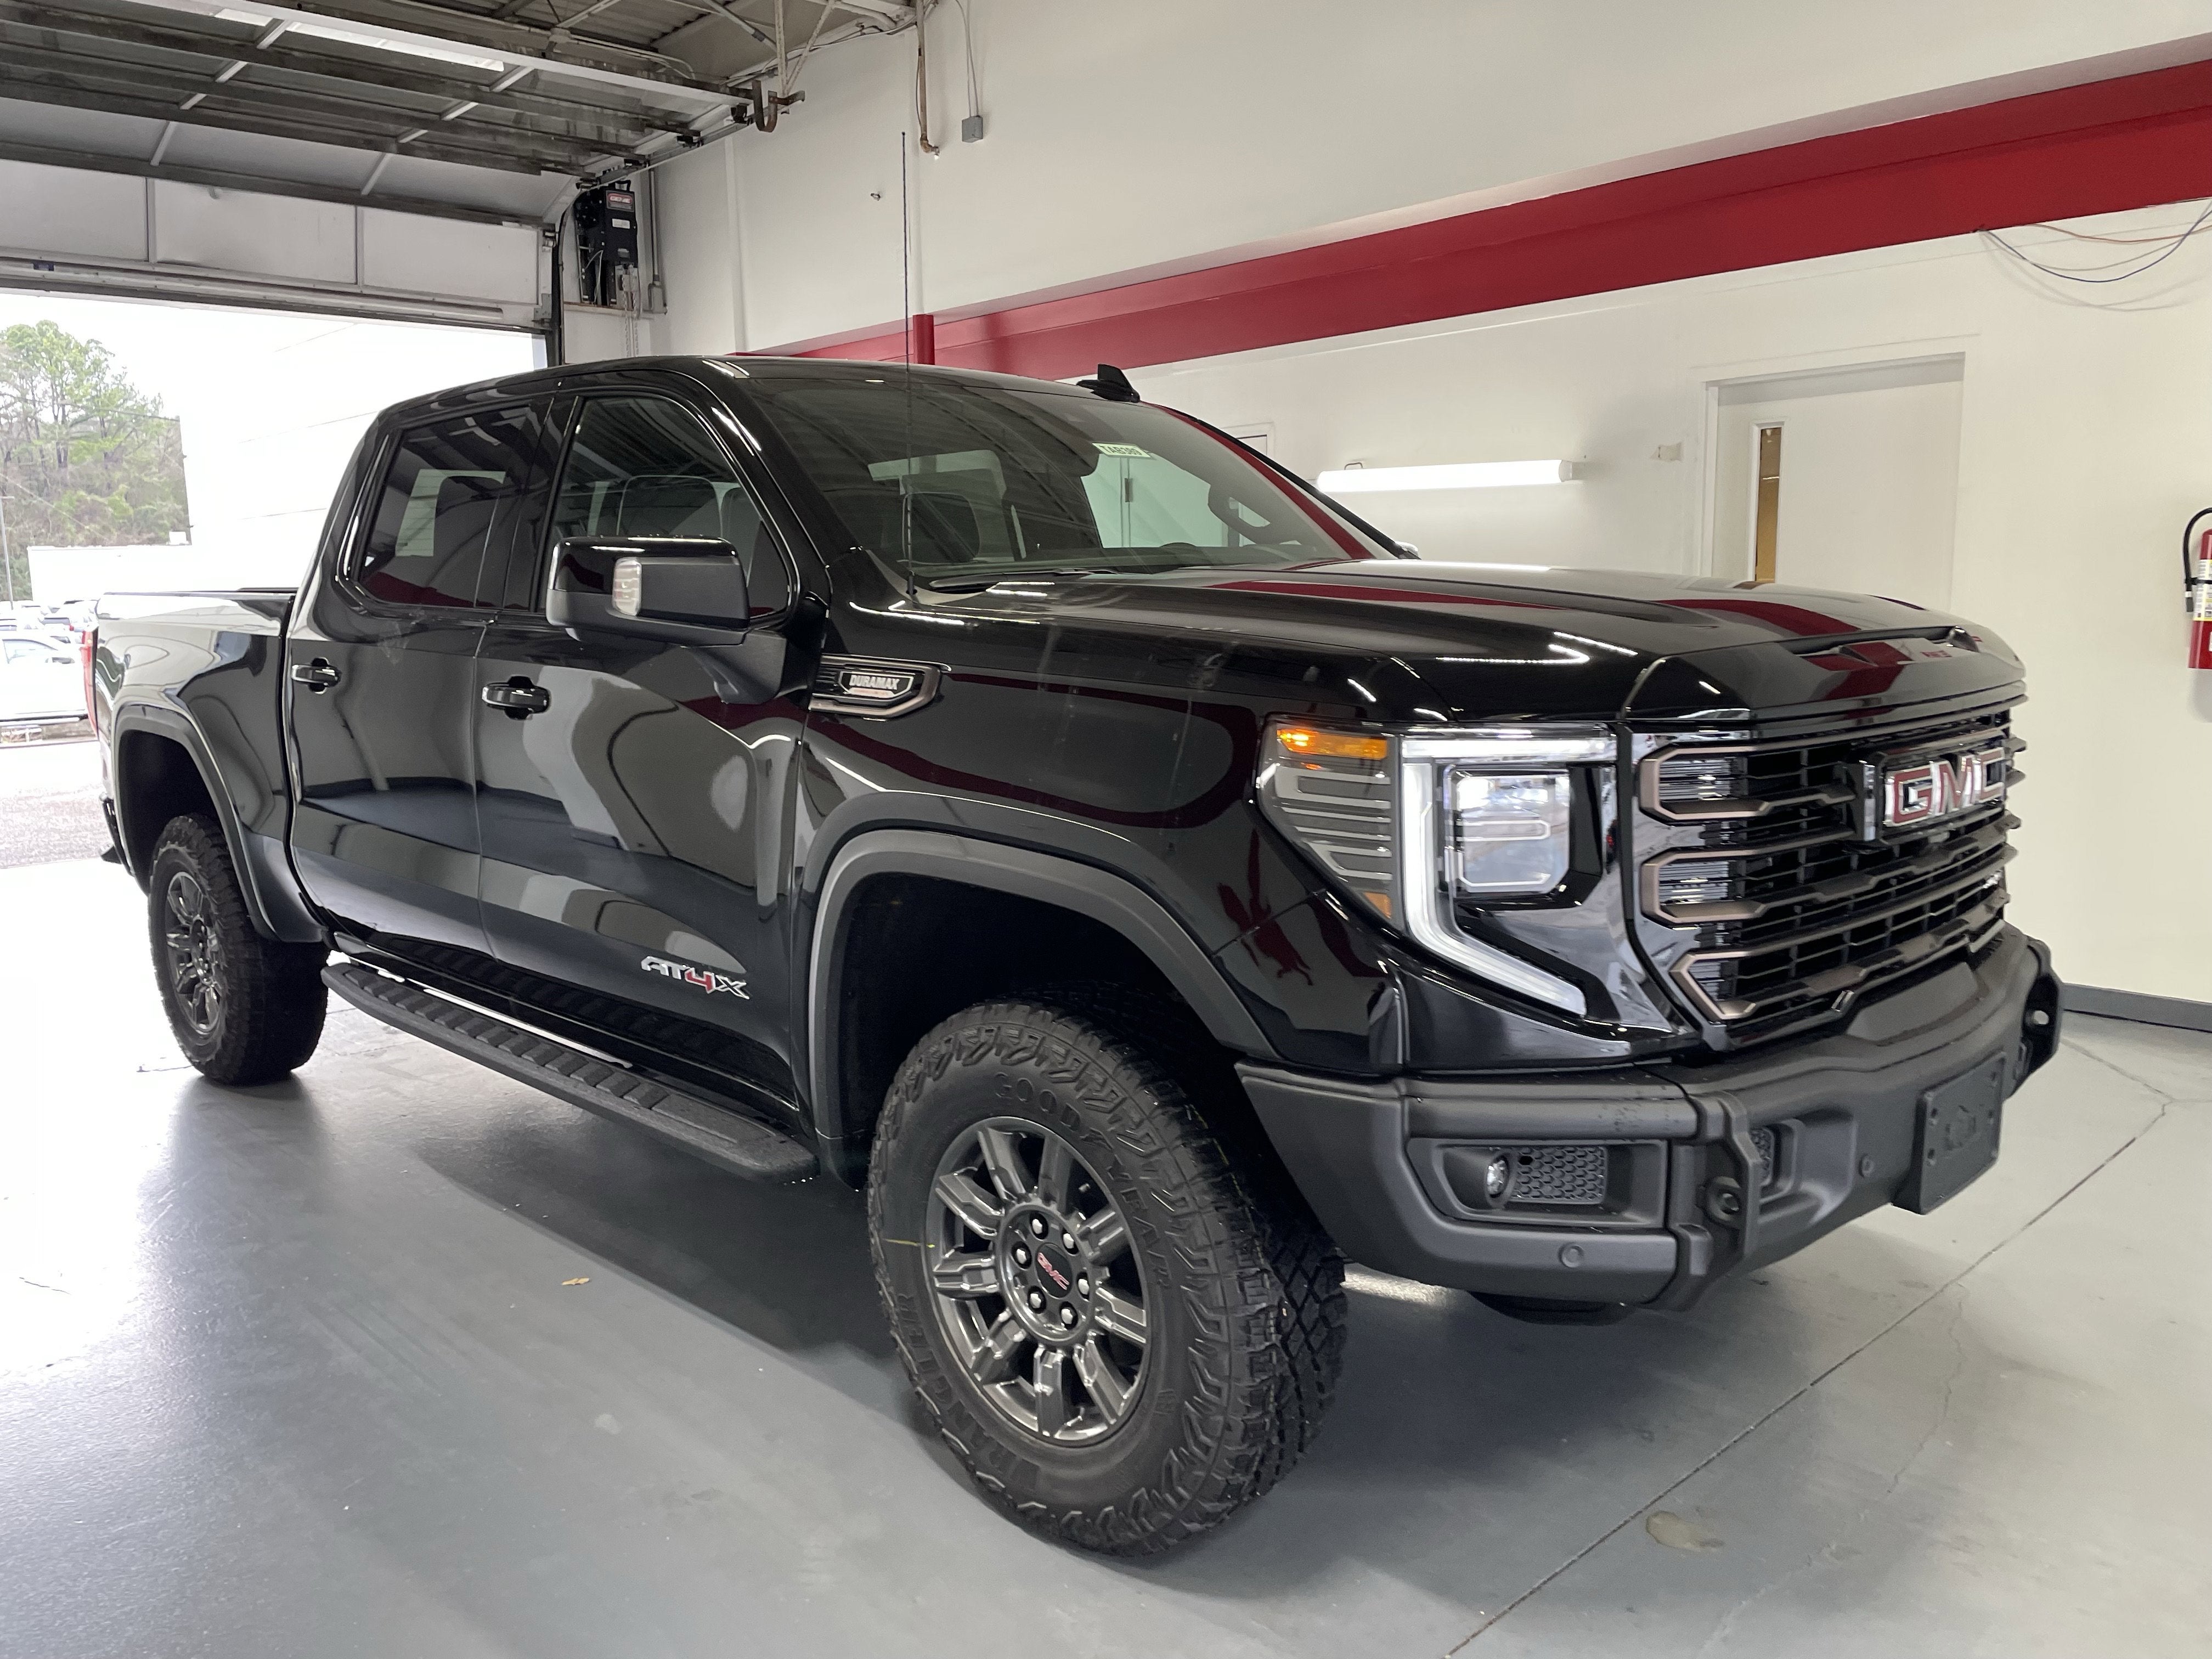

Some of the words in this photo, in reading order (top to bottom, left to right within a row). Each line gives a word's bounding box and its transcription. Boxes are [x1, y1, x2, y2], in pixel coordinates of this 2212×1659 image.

[849, 674, 900, 690] DURAMAX
[1884, 747, 2005, 826] GMC
[640, 956, 749, 1000] AT4X
[1037, 1252, 1070, 1290] GMC
